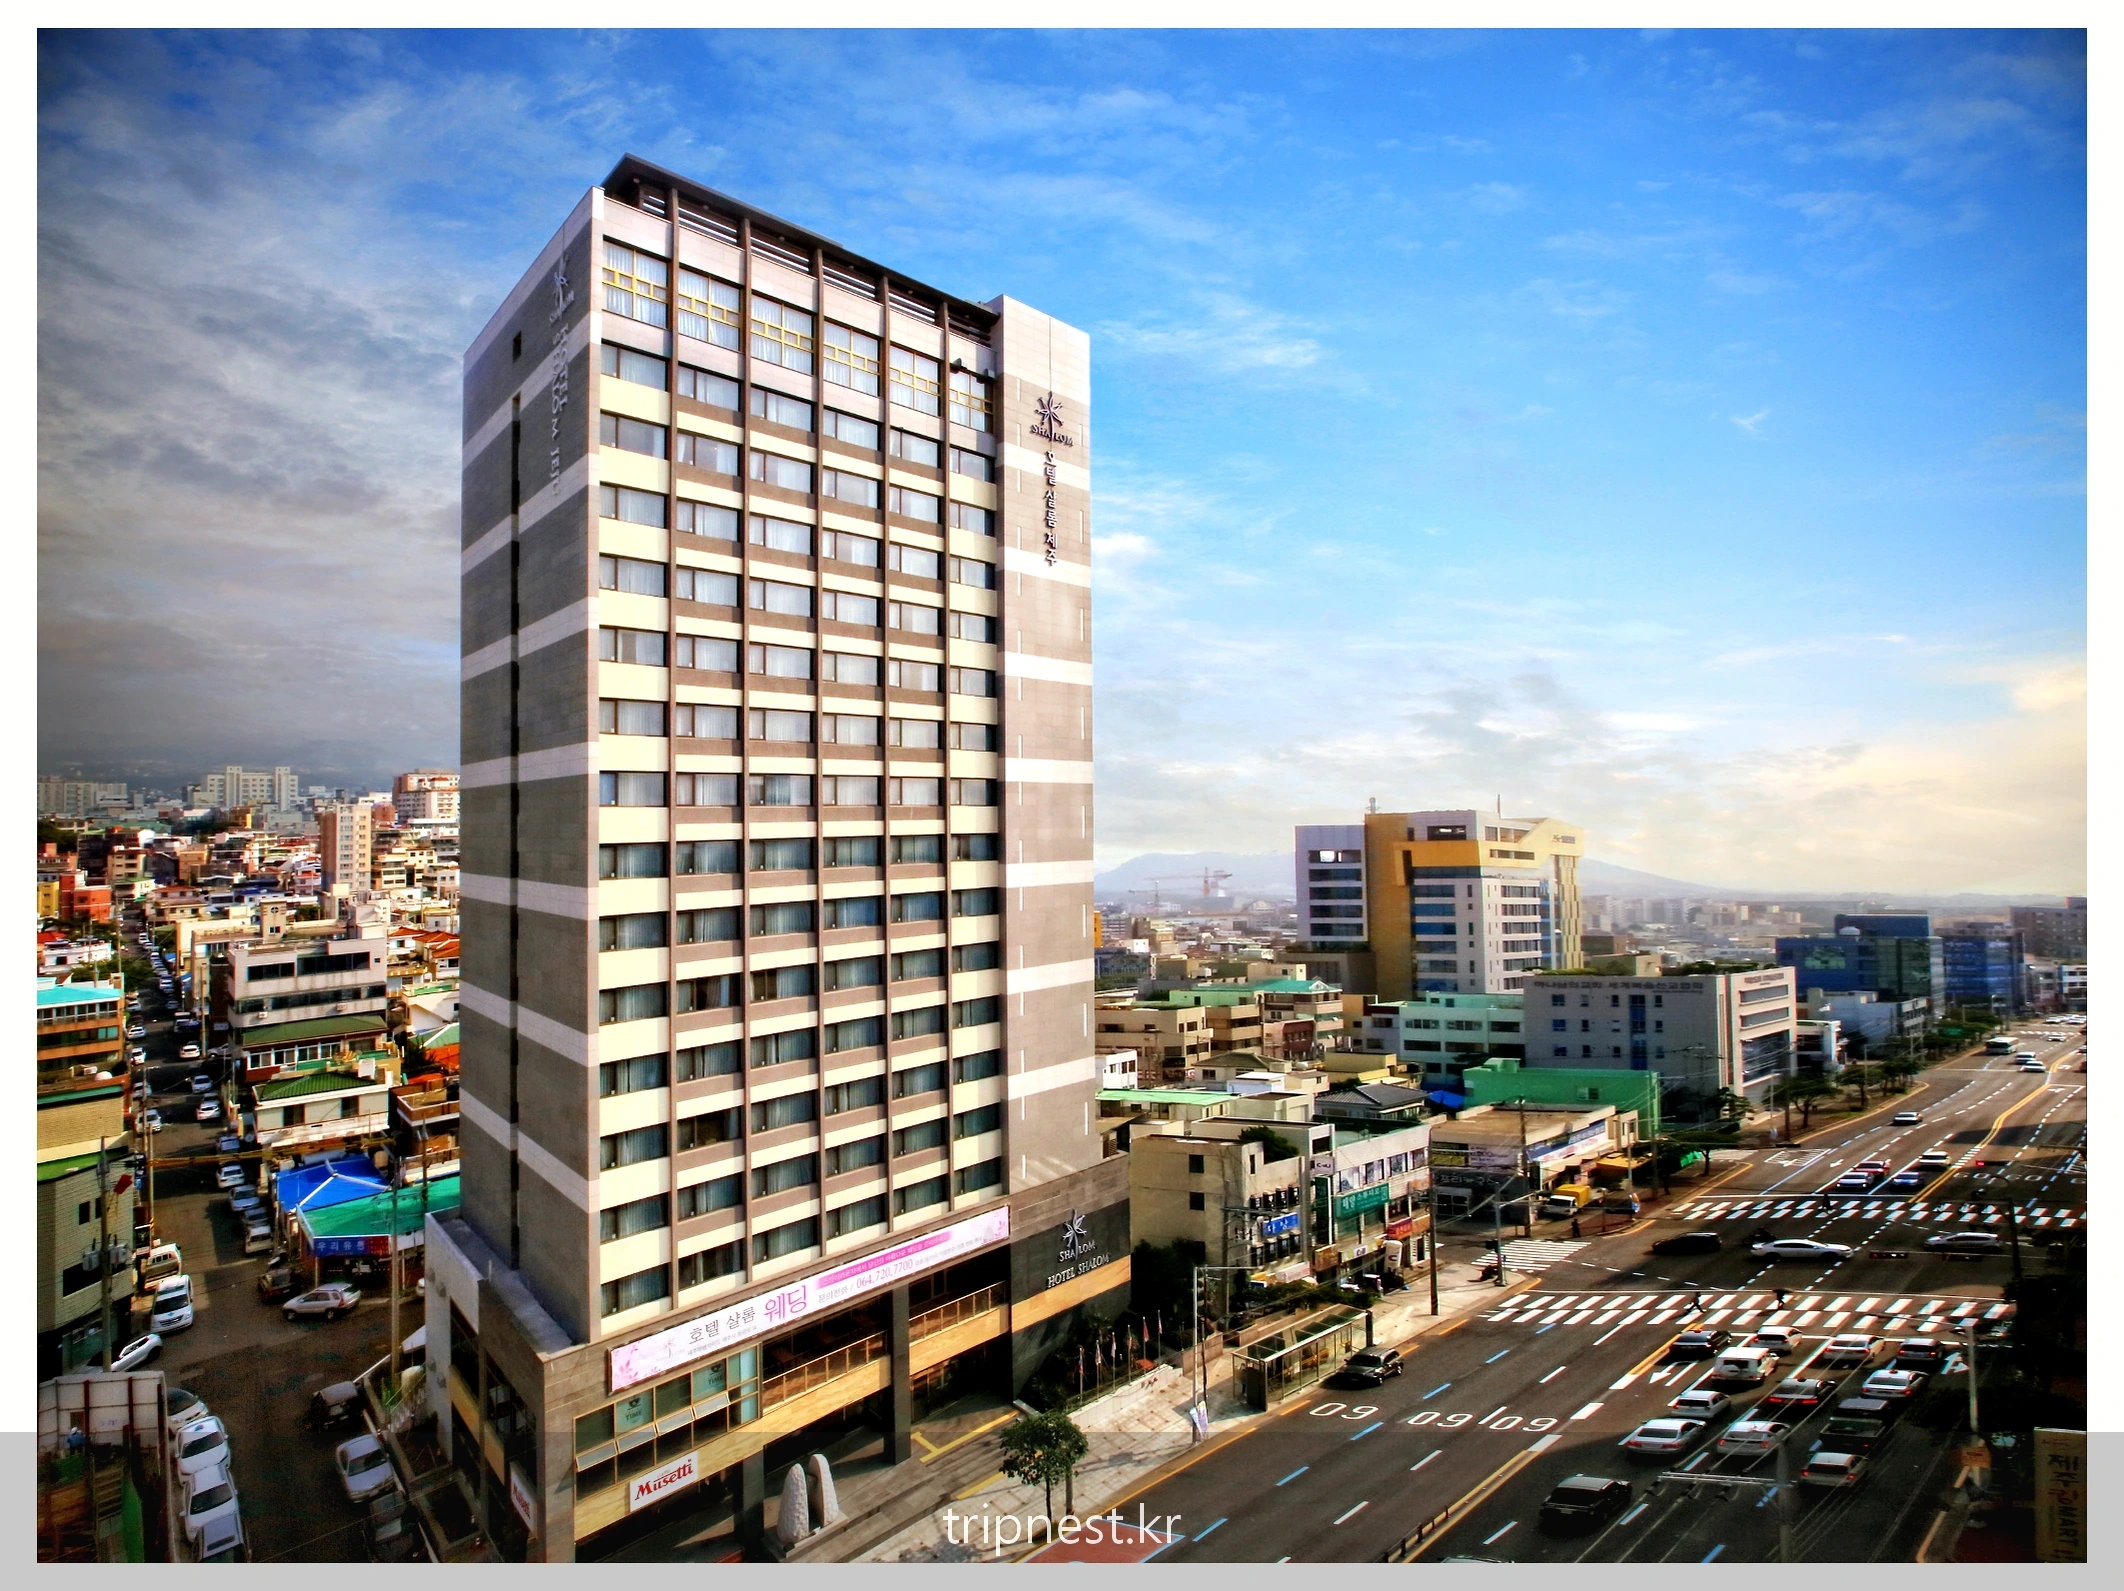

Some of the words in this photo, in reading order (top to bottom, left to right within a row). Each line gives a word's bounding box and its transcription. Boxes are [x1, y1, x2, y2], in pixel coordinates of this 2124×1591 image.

[1031, 423, 1075, 447] SHALOM
[1044, 450, 1057, 487] 호텔
[1044, 532, 1058, 567] 제주
[317, 1240, 366, 1252] 우리유통
[1059, 1240, 1096, 1262] SHALOM
[818, 1284, 849, 1304] 문의전화
[856, 1259, 913, 1289] 064.720.7700
[1047, 1267, 1075, 1288] HOTEL
[1077, 1252, 1111, 1275] SHALOM
[689, 1319, 720, 1345] 호텔
[726, 1306, 756, 1330] 샬롬
[764, 1285, 807, 1323] 웨딩
[708, 1375, 723, 1386] TIME
[626, 1409, 642, 1421] TIME
[634, 1462, 694, 1501] Musetti
